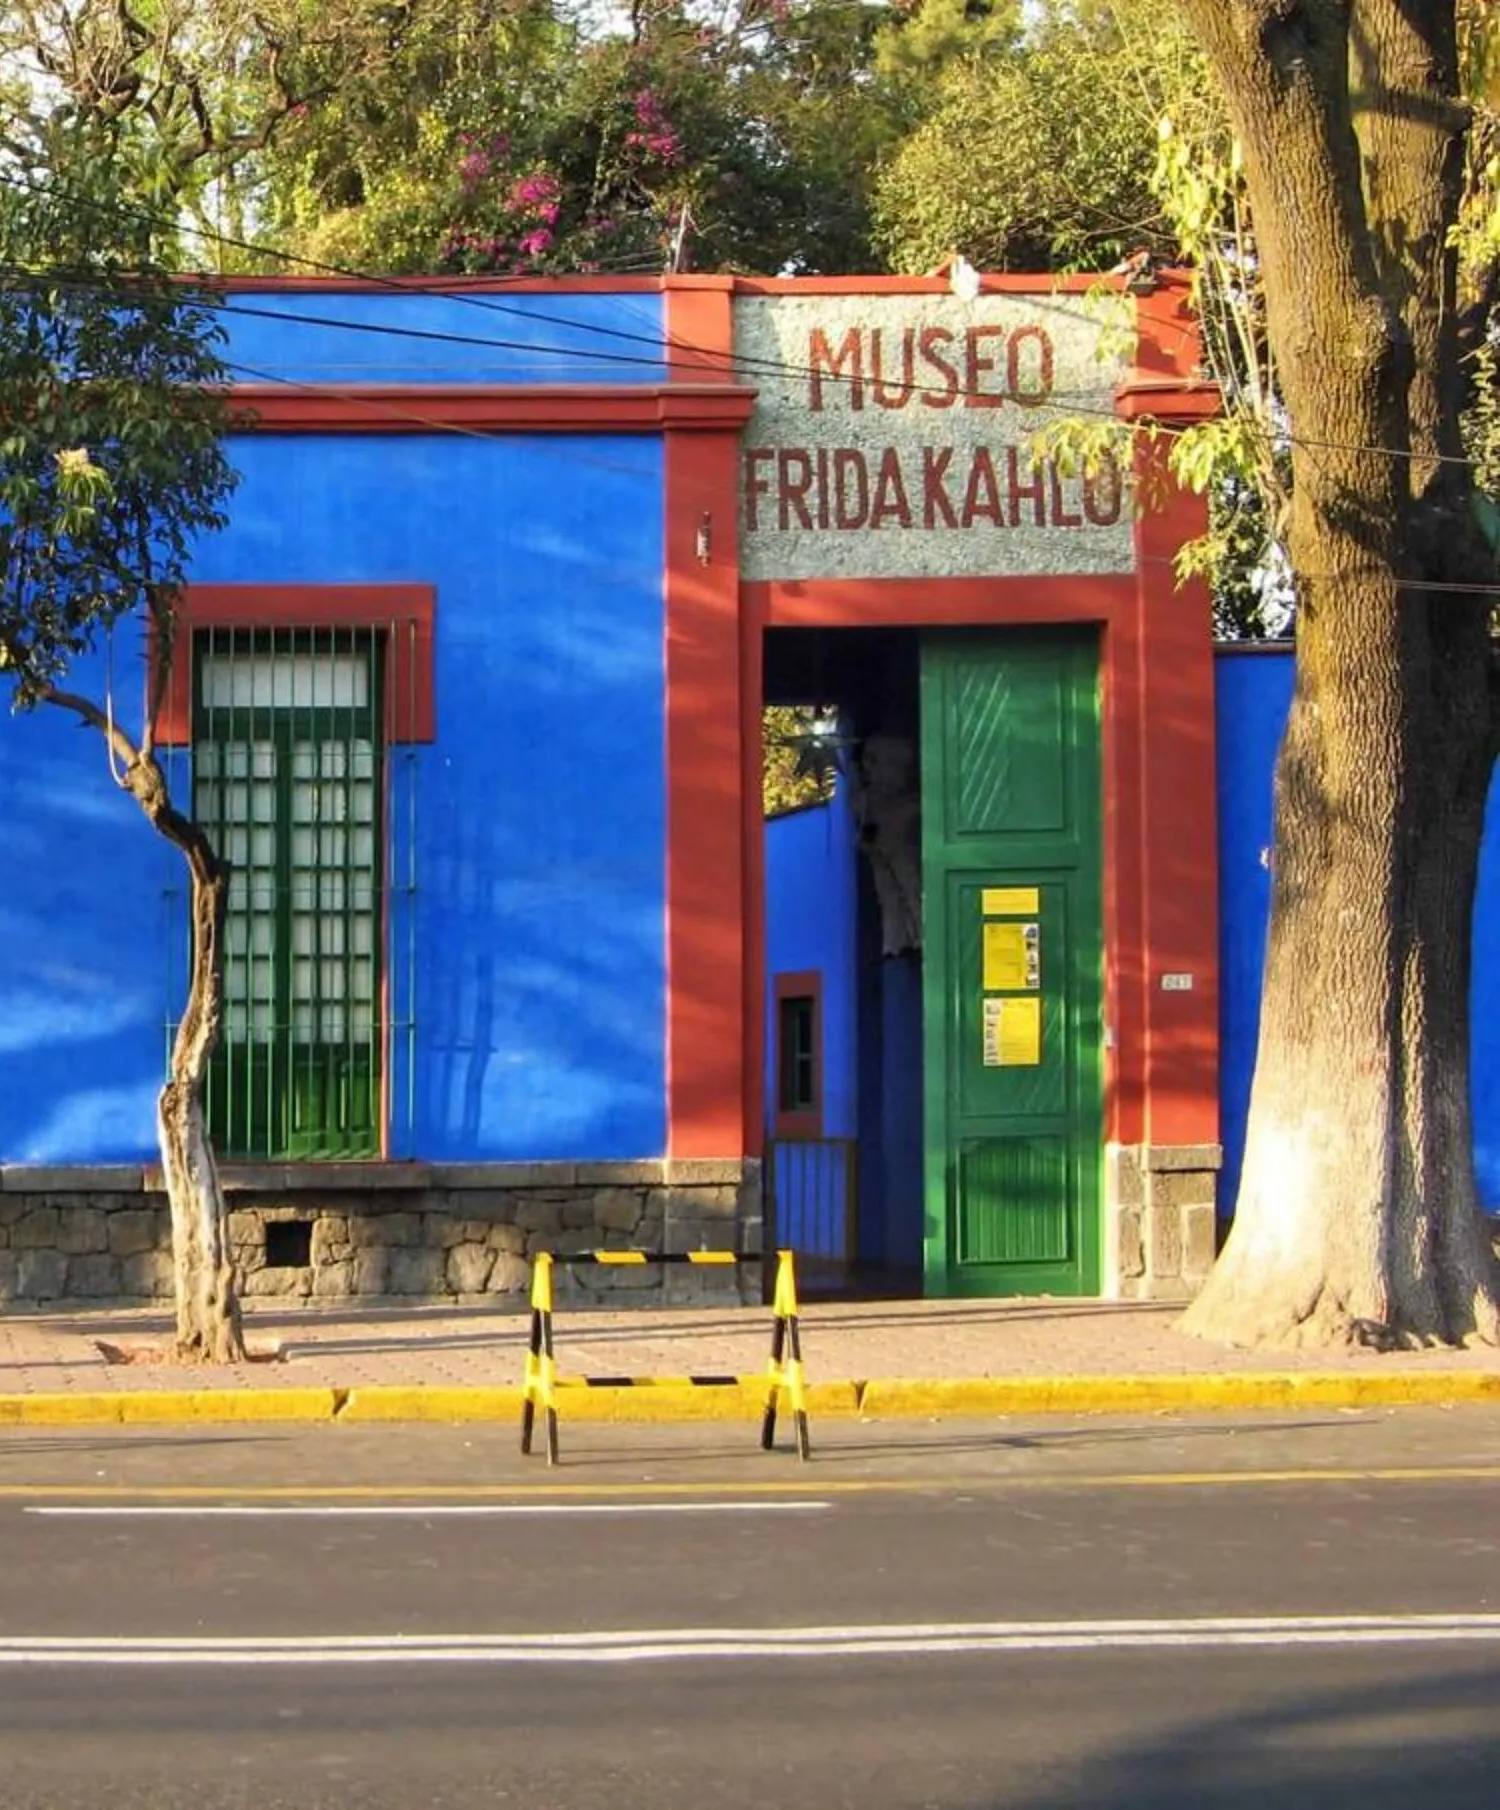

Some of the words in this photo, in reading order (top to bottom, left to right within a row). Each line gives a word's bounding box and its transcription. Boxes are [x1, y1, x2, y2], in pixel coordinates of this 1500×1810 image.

[808, 325, 1053, 412] MUSEO
[744, 446, 912, 531] FRIDA
[922, 445, 1122, 530] KAHLO
